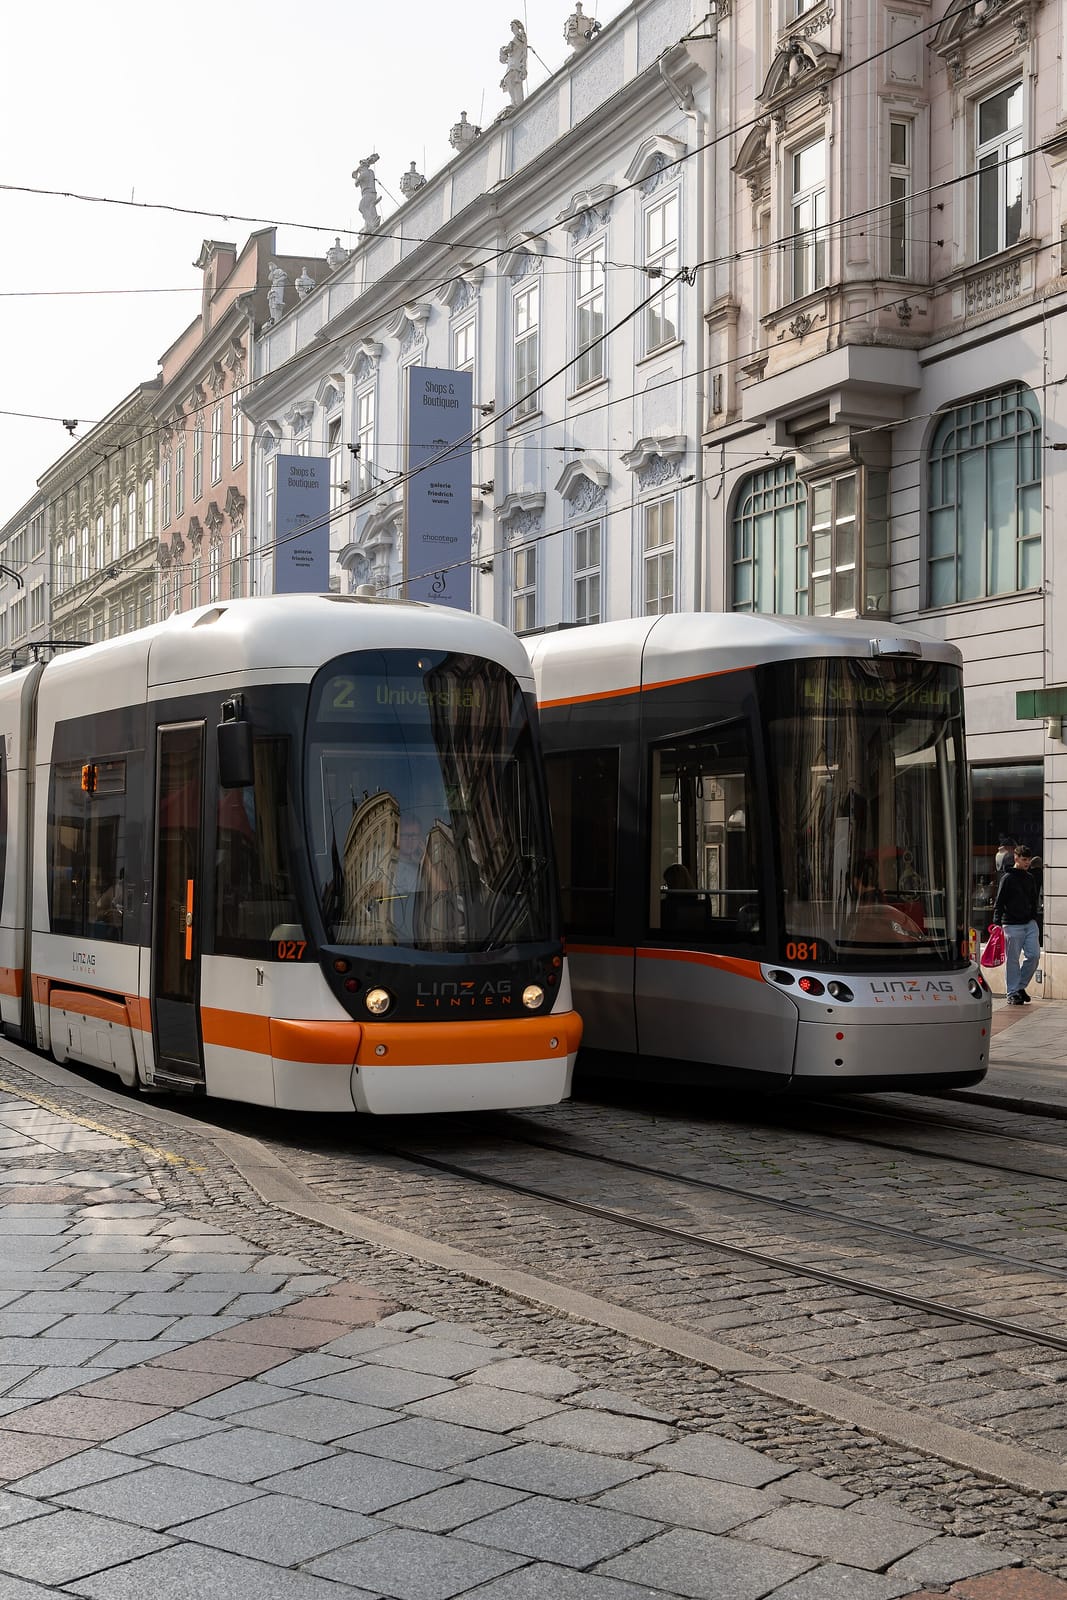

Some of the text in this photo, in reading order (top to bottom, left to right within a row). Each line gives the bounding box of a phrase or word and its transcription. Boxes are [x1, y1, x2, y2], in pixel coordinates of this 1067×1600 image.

[425, 381, 455, 395] Shops &
[423, 394, 459, 409] Boutiquen
[290, 466, 316, 477] Shops &
[288, 477, 320, 489] Boutiquen
[427, 490, 454, 498] friedrich
[333, 679, 355, 708] 2
[278, 940, 307, 959] 027
[786, 942, 818, 961] 081
[417, 980, 512, 996] LINZ AG
[869, 981, 954, 994] LINZ AG
[416, 996, 512, 1007] LINIEN
[874, 994, 958, 1003] LINIEN
